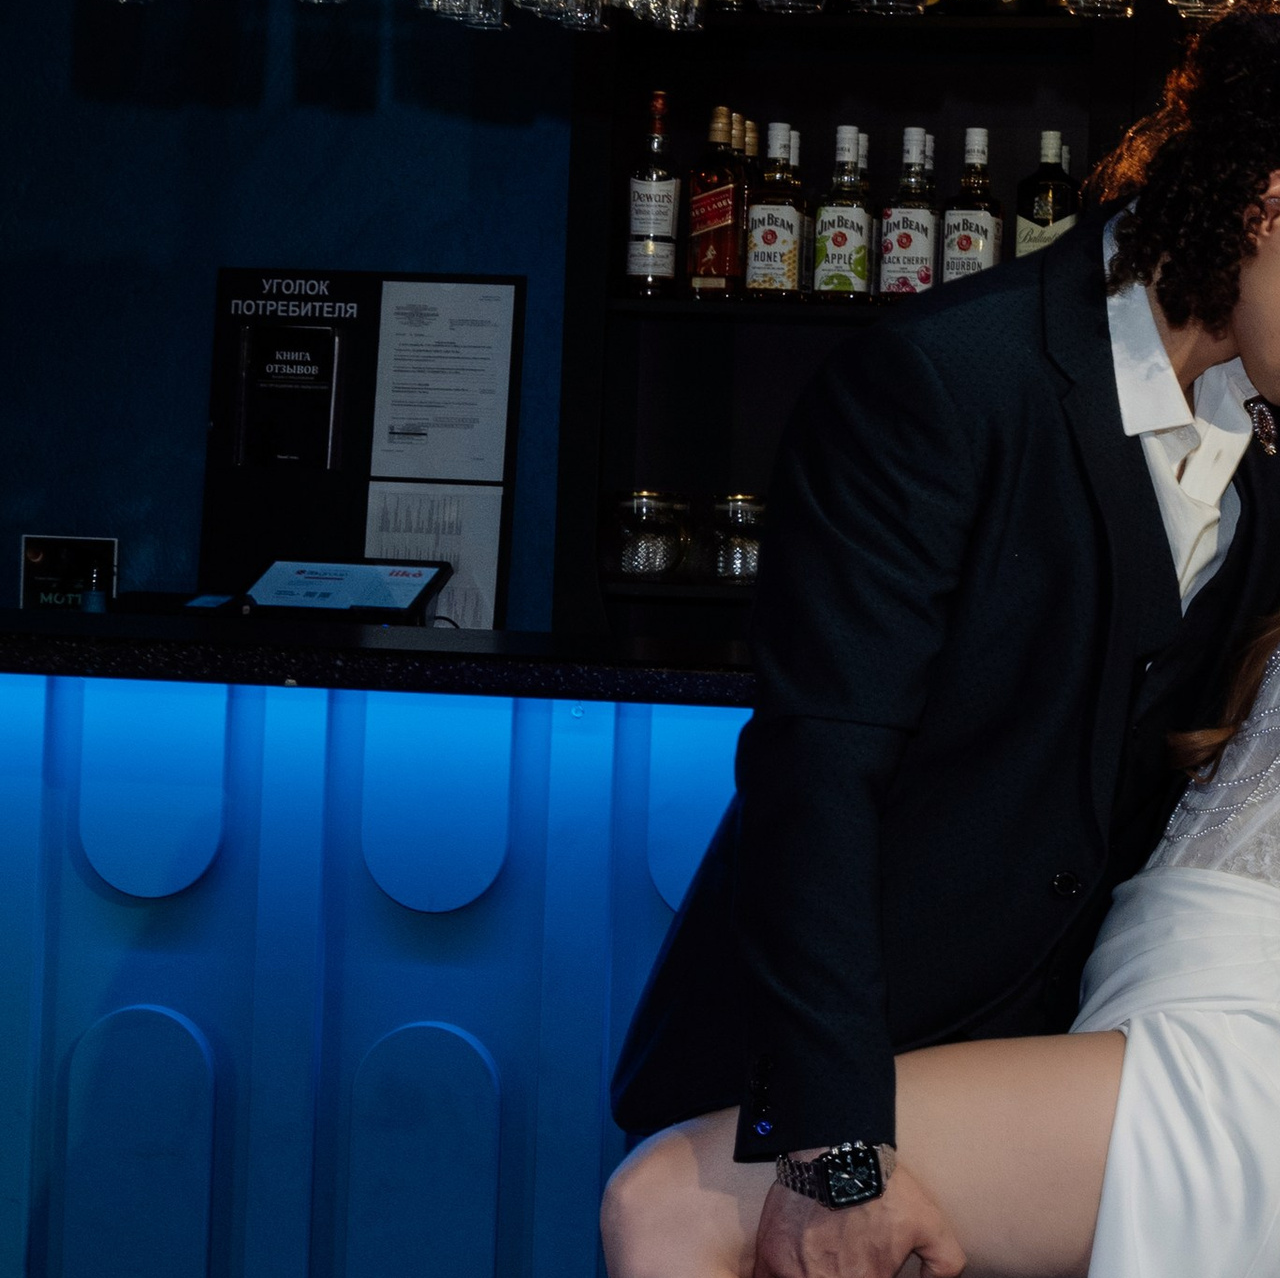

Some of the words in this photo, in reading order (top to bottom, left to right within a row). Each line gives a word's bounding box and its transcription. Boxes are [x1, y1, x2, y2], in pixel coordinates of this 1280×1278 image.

[750, 217, 766, 231] JIM
[767, 213, 794, 235] BEAM
[818, 219, 836, 235] JIM
[838, 215, 865, 237] BEAM
[883, 221, 901, 236] JIM
[902, 217, 929, 238] BEAM
[945, 222, 961, 240] JIM
[962, 218, 988, 240] BEAM
[753, 251, 785, 263] HONEY
[825, 253, 854, 264] APPLE
[902, 256, 929, 265] CHERRY
[946, 260, 983, 272] BOURBON
[261, 278, 331, 296] УГОЛОК
[231, 299, 359, 319] ПОТРЕБИТЕЛЯ
[275, 350, 312, 362] КНИГА
[265, 363, 320, 375] ОТЗЫВОВ
